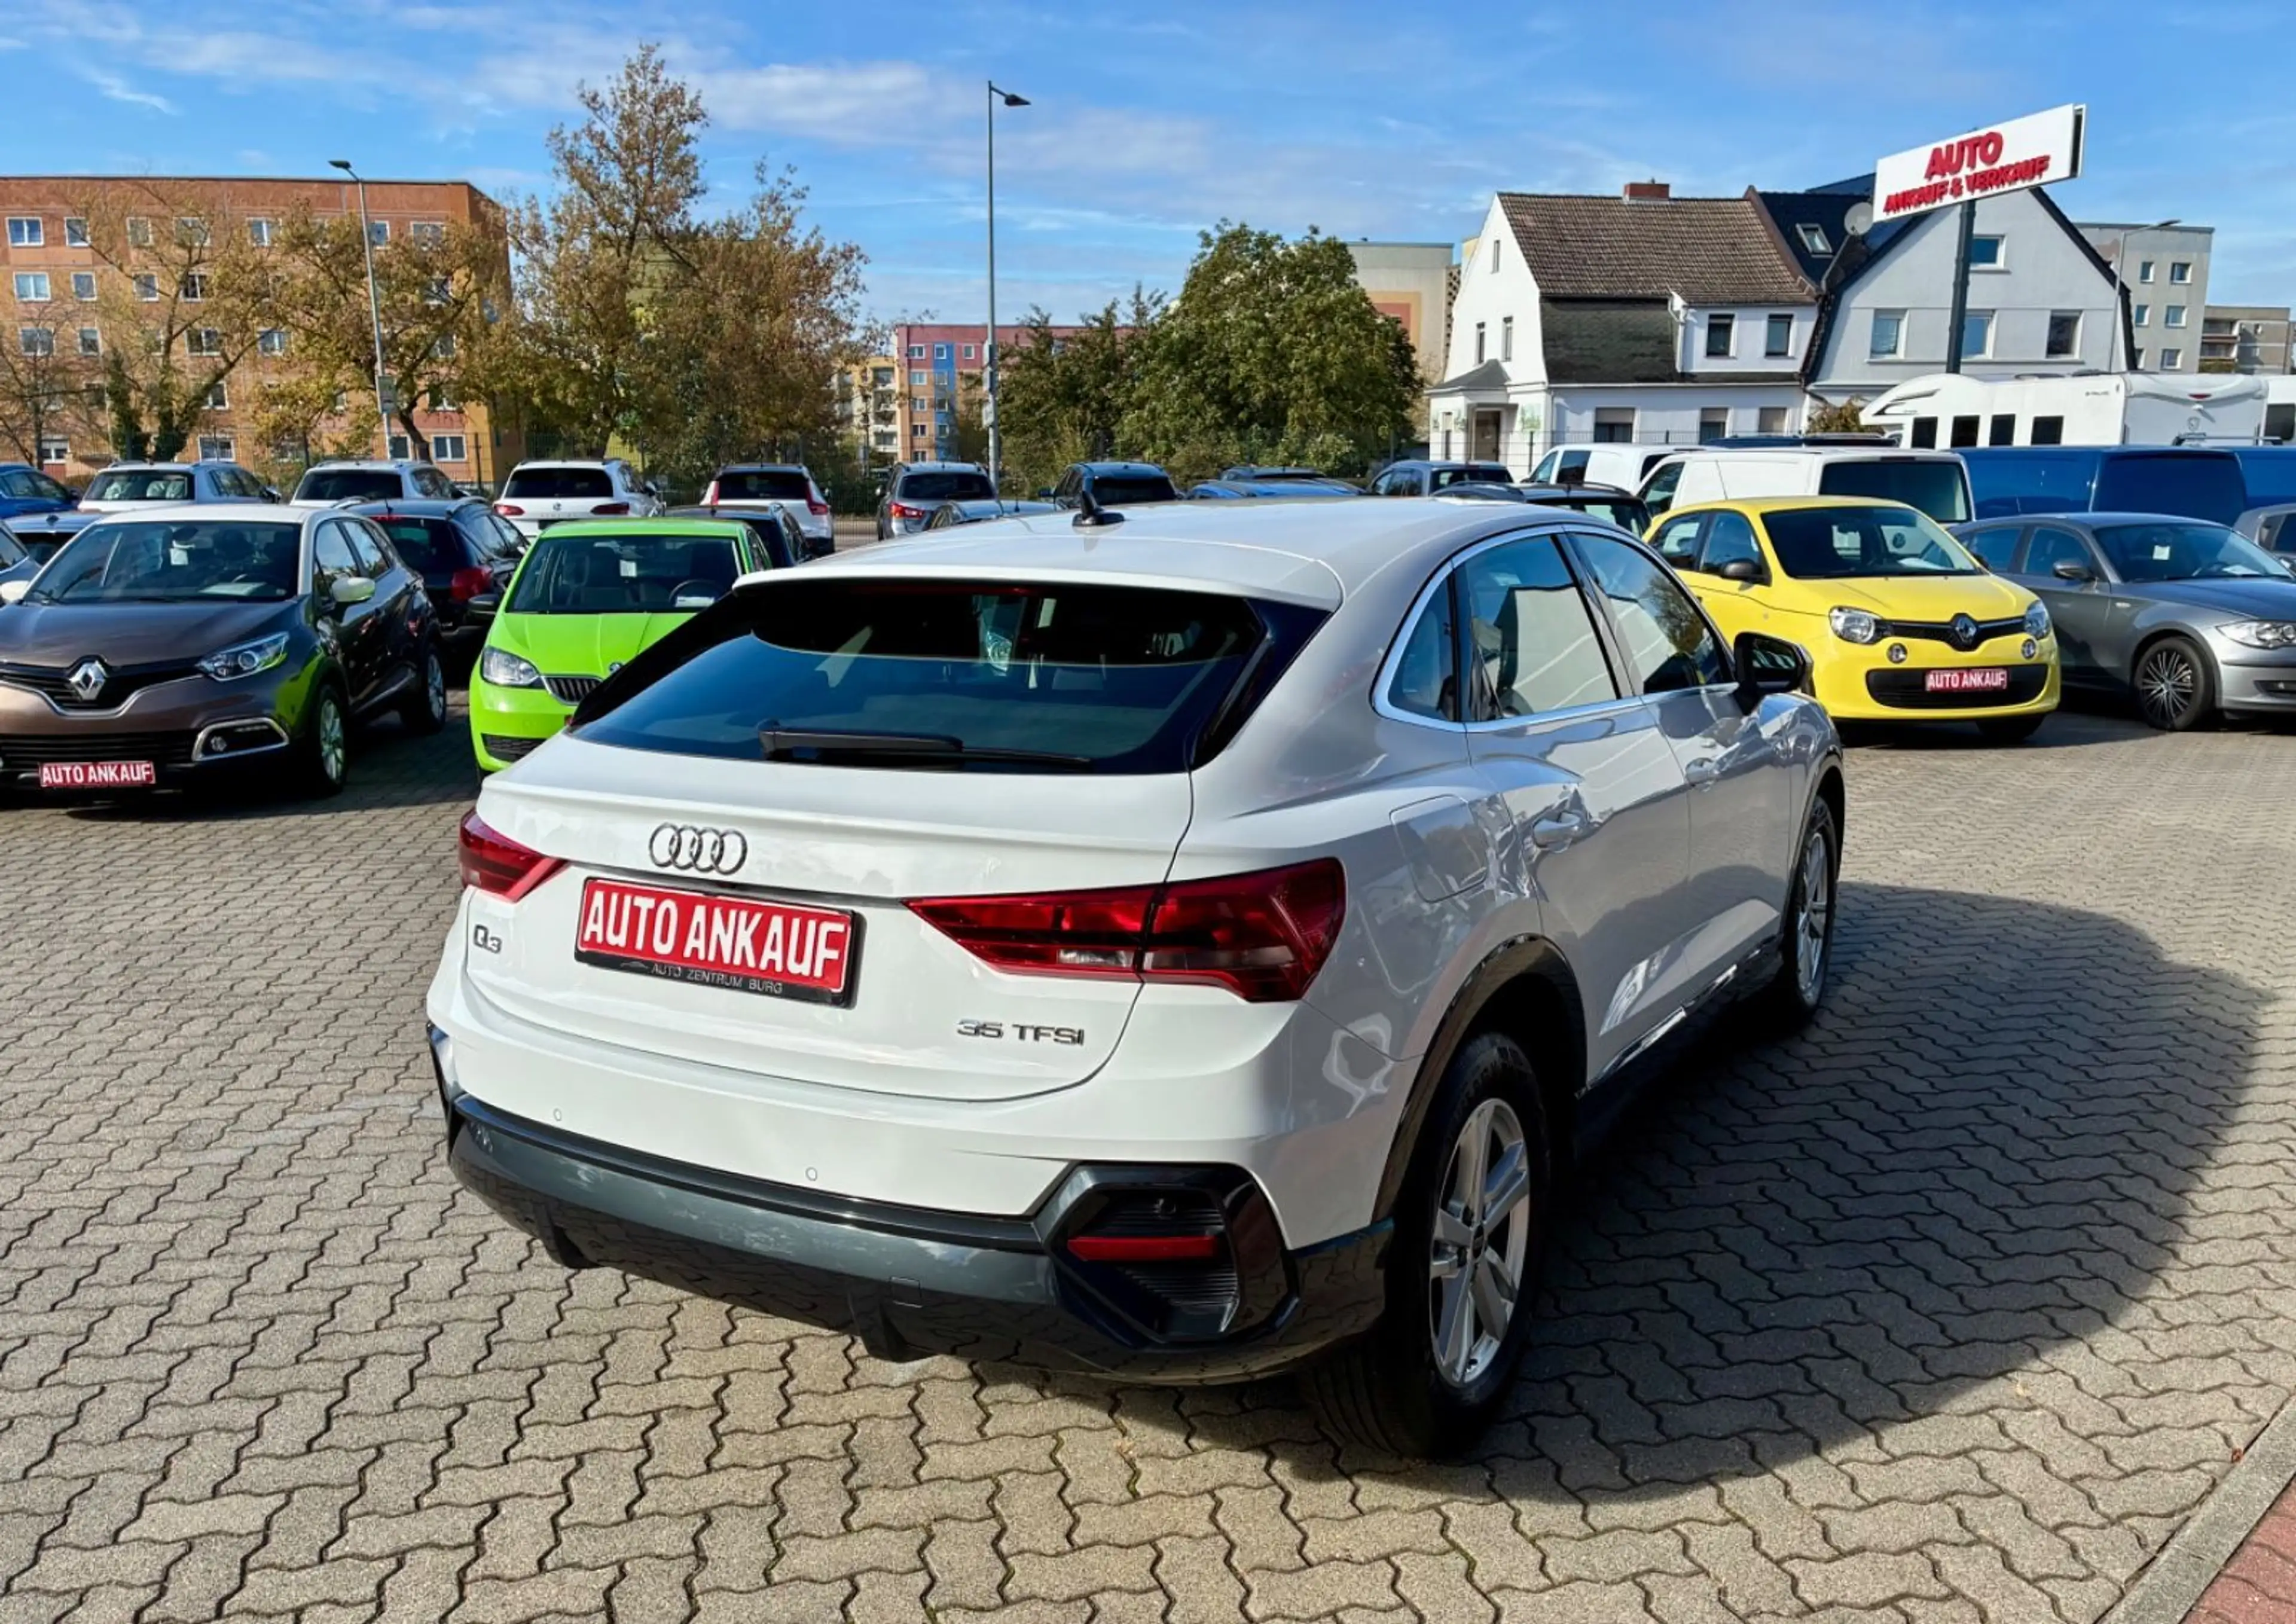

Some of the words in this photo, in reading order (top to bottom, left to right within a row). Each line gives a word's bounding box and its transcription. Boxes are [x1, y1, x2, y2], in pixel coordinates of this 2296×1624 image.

[1924, 132, 2004, 180] AUTO
[1883, 181, 1949, 213] ANKAUF
[1949, 178, 1964, 199] &
[1965, 155, 2051, 194] VERKAUF
[1928, 673, 1959, 689] AUTO
[1961, 671, 2005, 688] ANKAUF
[42, 765, 84, 784] AUTO
[88, 763, 151, 783] ANKAUF
[474, 924, 503, 954] Q3
[583, 890, 679, 956] AUTO
[683, 905, 846, 978] ANKAUF
[651, 963, 681, 978] AUTO
[687, 969, 743, 988] ZENTRUM
[749, 978, 783, 994] BURG
[957, 1018, 1004, 1039] 35
[1012, 1023, 1085, 1046] TFSI
